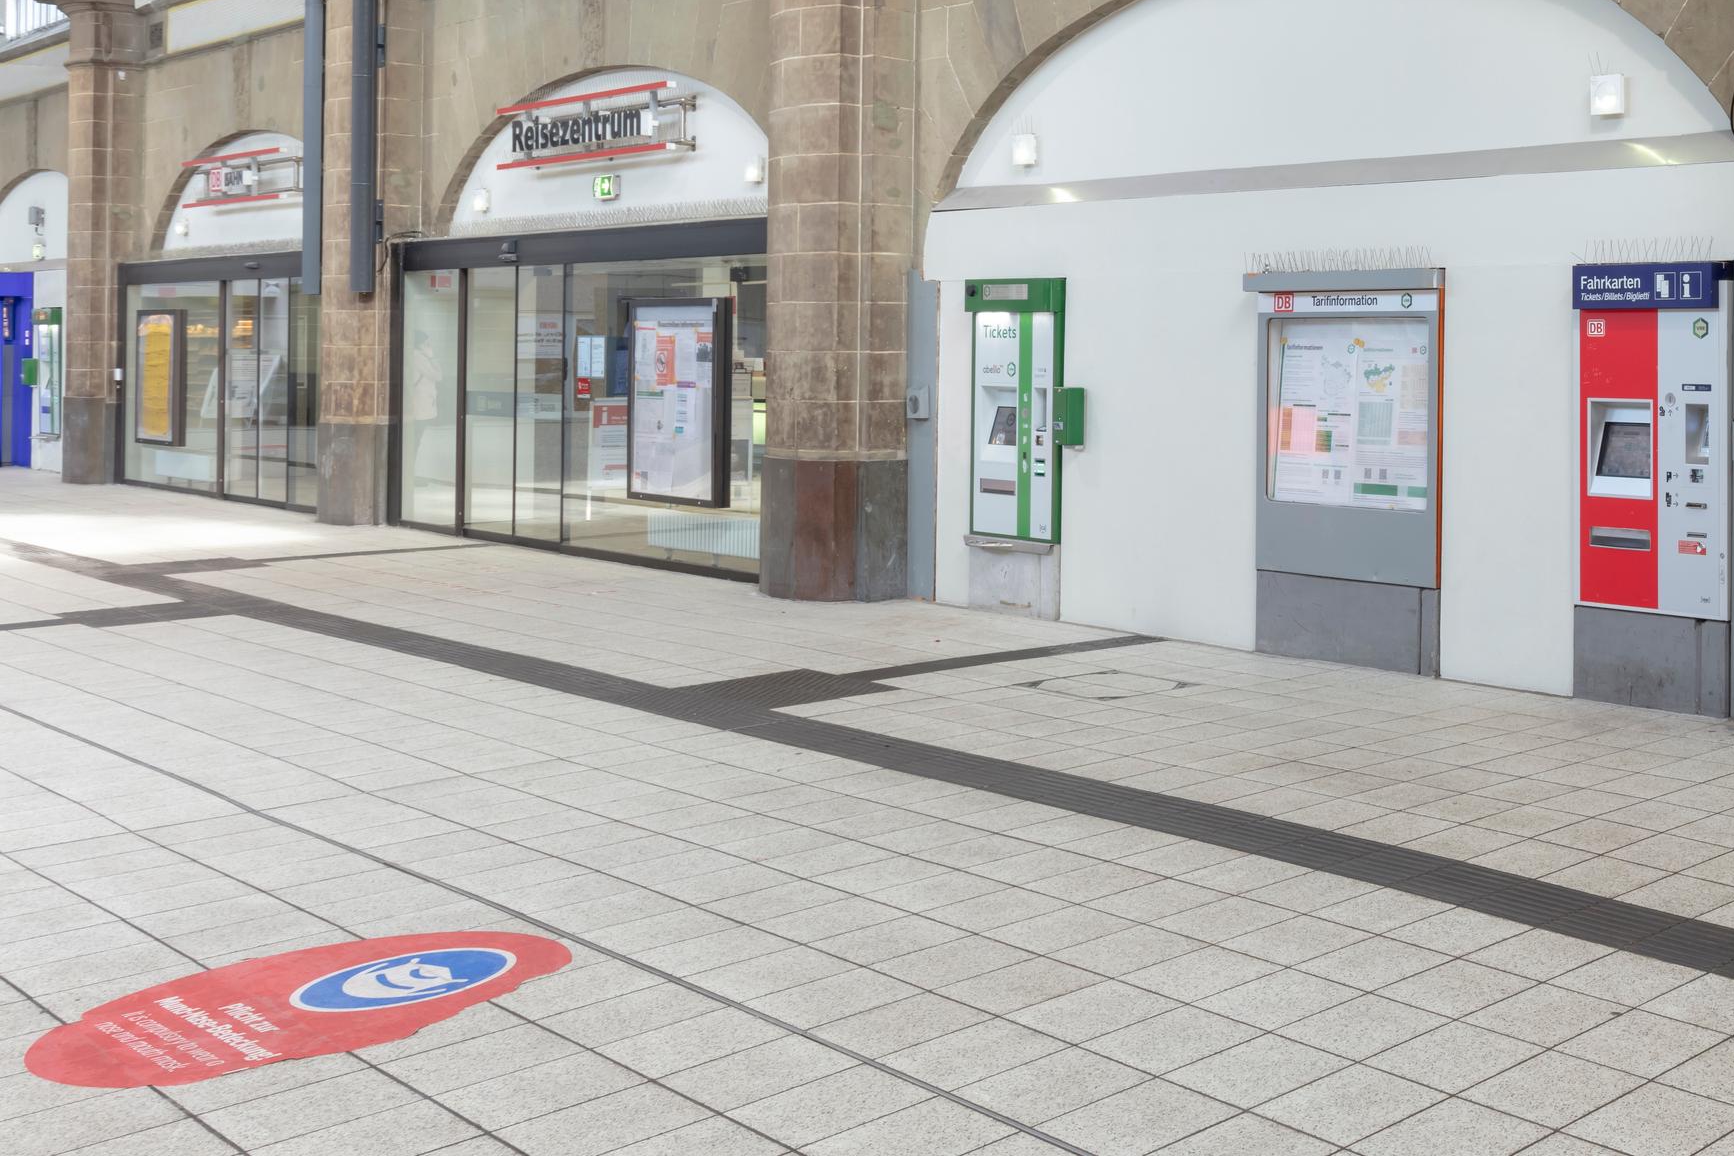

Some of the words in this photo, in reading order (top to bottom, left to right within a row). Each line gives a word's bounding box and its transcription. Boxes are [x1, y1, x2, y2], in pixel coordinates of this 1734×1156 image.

[512, 109, 641, 153] Reisezentrum
[1580, 276, 1641, 290] Fahrkarten
[1311, 295, 1378, 307] Tarifinformation
[1580, 291, 1650, 302] Tickets/Billets/Biglietti
[983, 325, 1017, 339] Tickets
[217, 1002, 267, 1027] Pflicht
[253, 1020, 281, 1034] zur
[154, 996, 282, 1062] Mund-Nase-Bedeckung!
